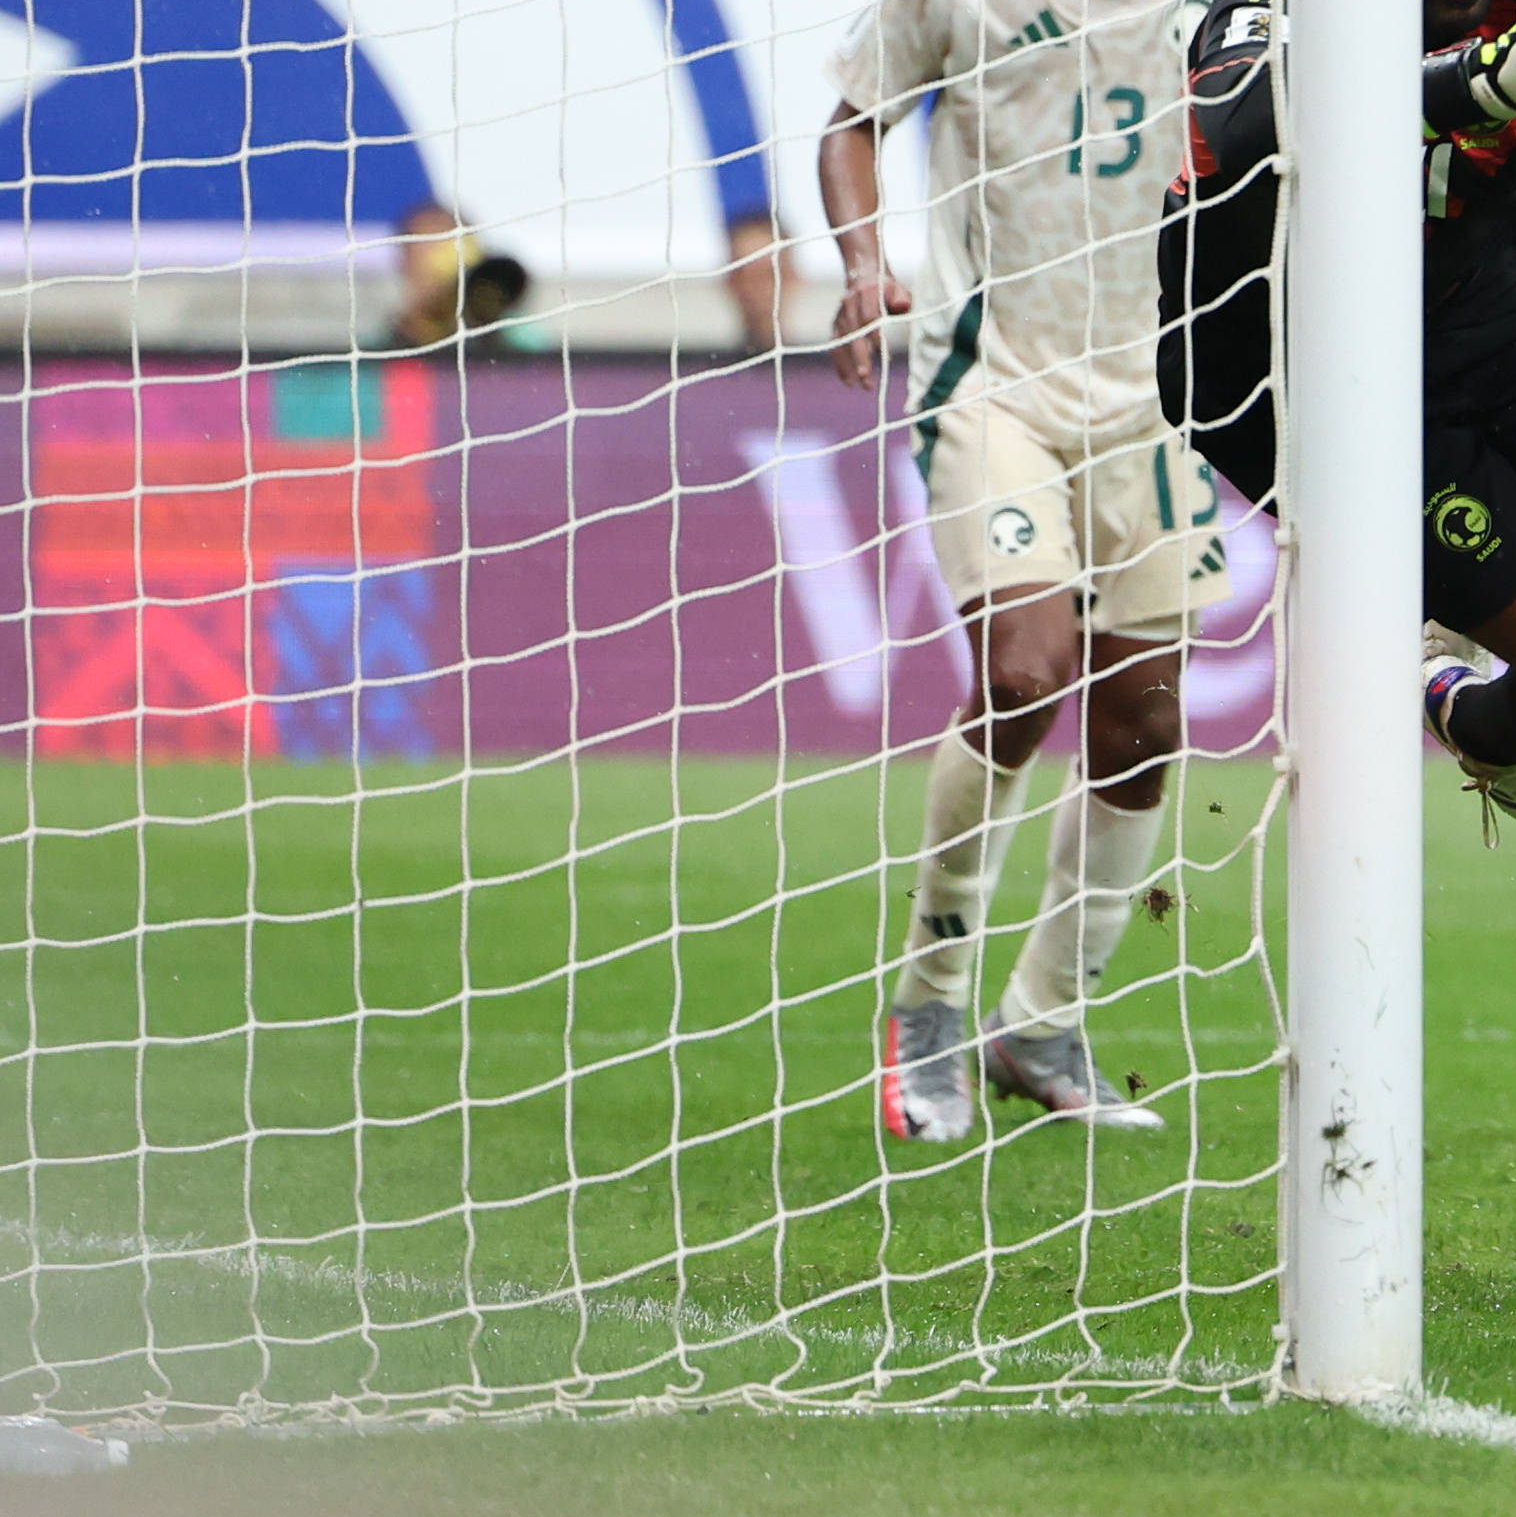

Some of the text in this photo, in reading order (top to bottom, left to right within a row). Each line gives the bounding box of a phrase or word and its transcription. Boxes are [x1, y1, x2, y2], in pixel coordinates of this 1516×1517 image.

[1068, 87, 1145, 178] 13
[1460, 137, 1500, 151] SAUDI
[1422, 142, 1454, 219] 1
[1476, 536, 1503, 563] SAUDI
